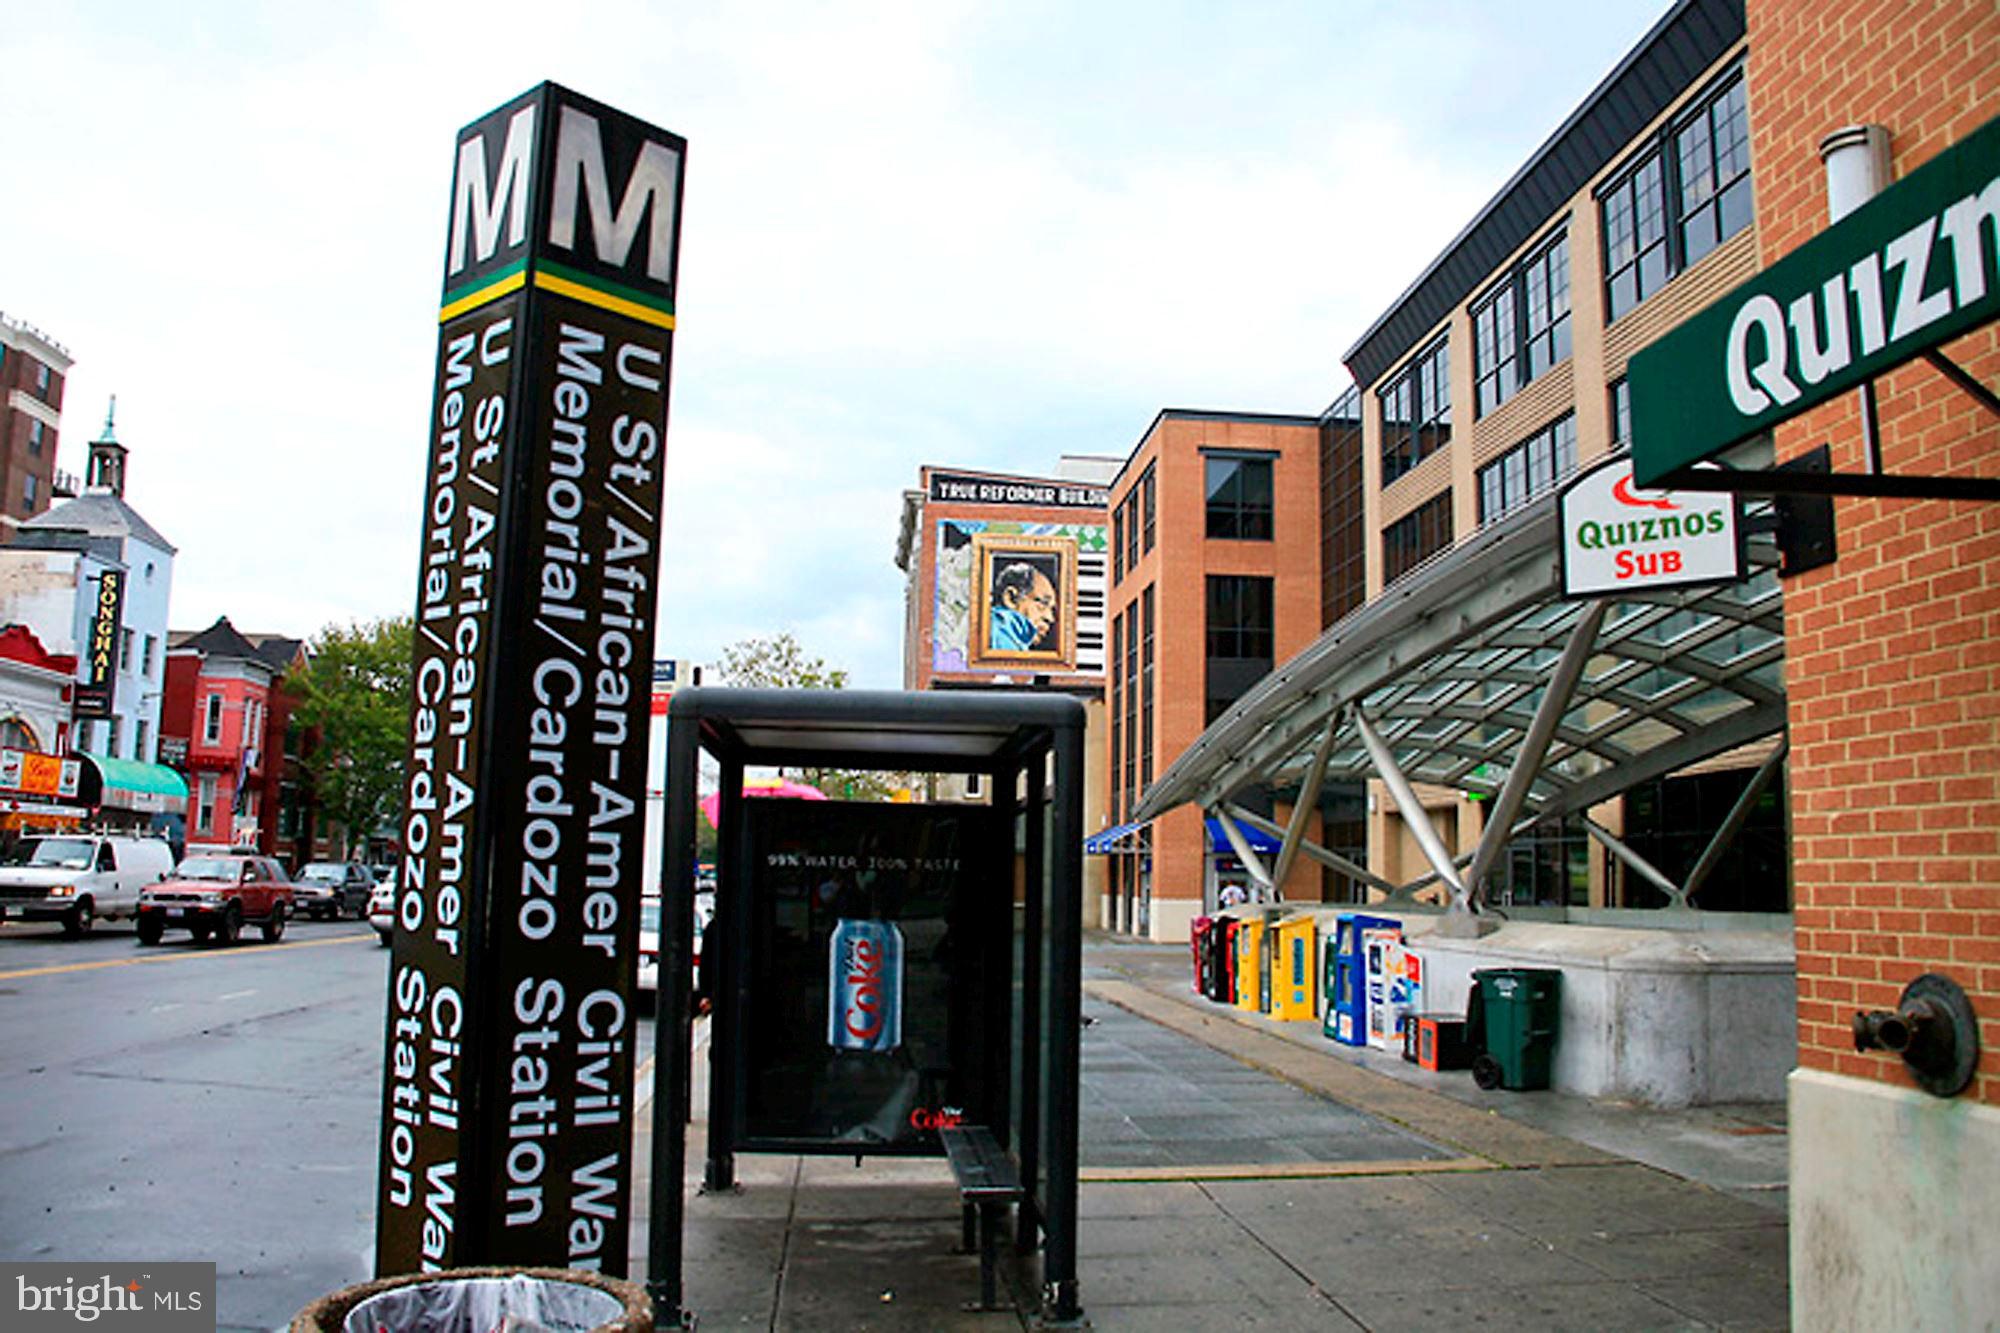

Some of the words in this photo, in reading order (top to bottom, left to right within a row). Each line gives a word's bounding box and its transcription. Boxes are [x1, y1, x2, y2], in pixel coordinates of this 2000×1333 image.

[449, 103, 537, 277] M
[549, 106, 680, 284] M
[481, 317, 512, 366] U
[616, 343, 662, 392] U
[939, 481, 977, 500] TRUE
[980, 484, 1056, 501] REFORMER
[94, 574, 117, 683] SONGHAI
[401, 332, 476, 931] Memorial/Cardozo
[518, 323, 605, 940] Memorial/Cardozo
[429, 987, 463, 1130] Civil
[575, 989, 626, 1126] Civil
[845, 939, 883, 1040] Coke
[390, 966, 426, 1207] Station
[506, 976, 564, 1227] Station
